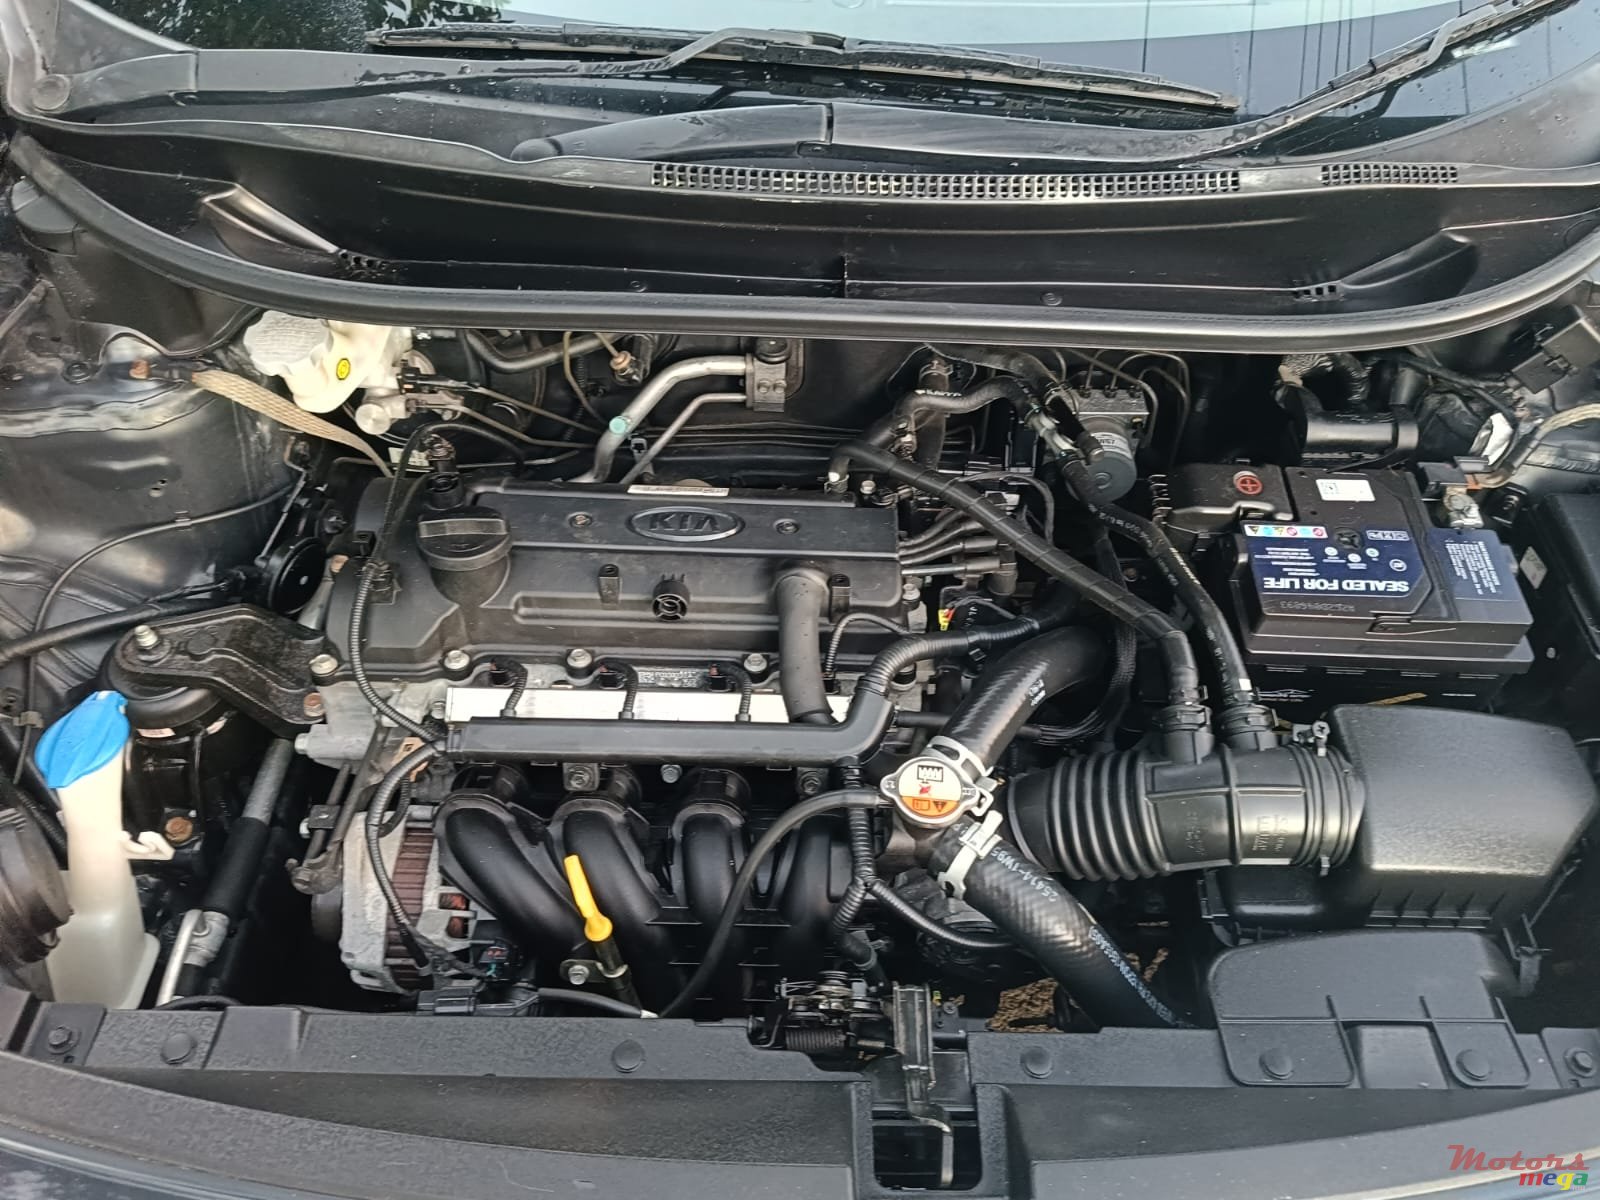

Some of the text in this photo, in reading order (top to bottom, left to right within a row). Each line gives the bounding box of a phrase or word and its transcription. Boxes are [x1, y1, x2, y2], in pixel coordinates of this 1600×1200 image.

[649, 512, 720, 532] KIA
[1263, 577, 1410, 593] SEALED FOR LIFE
